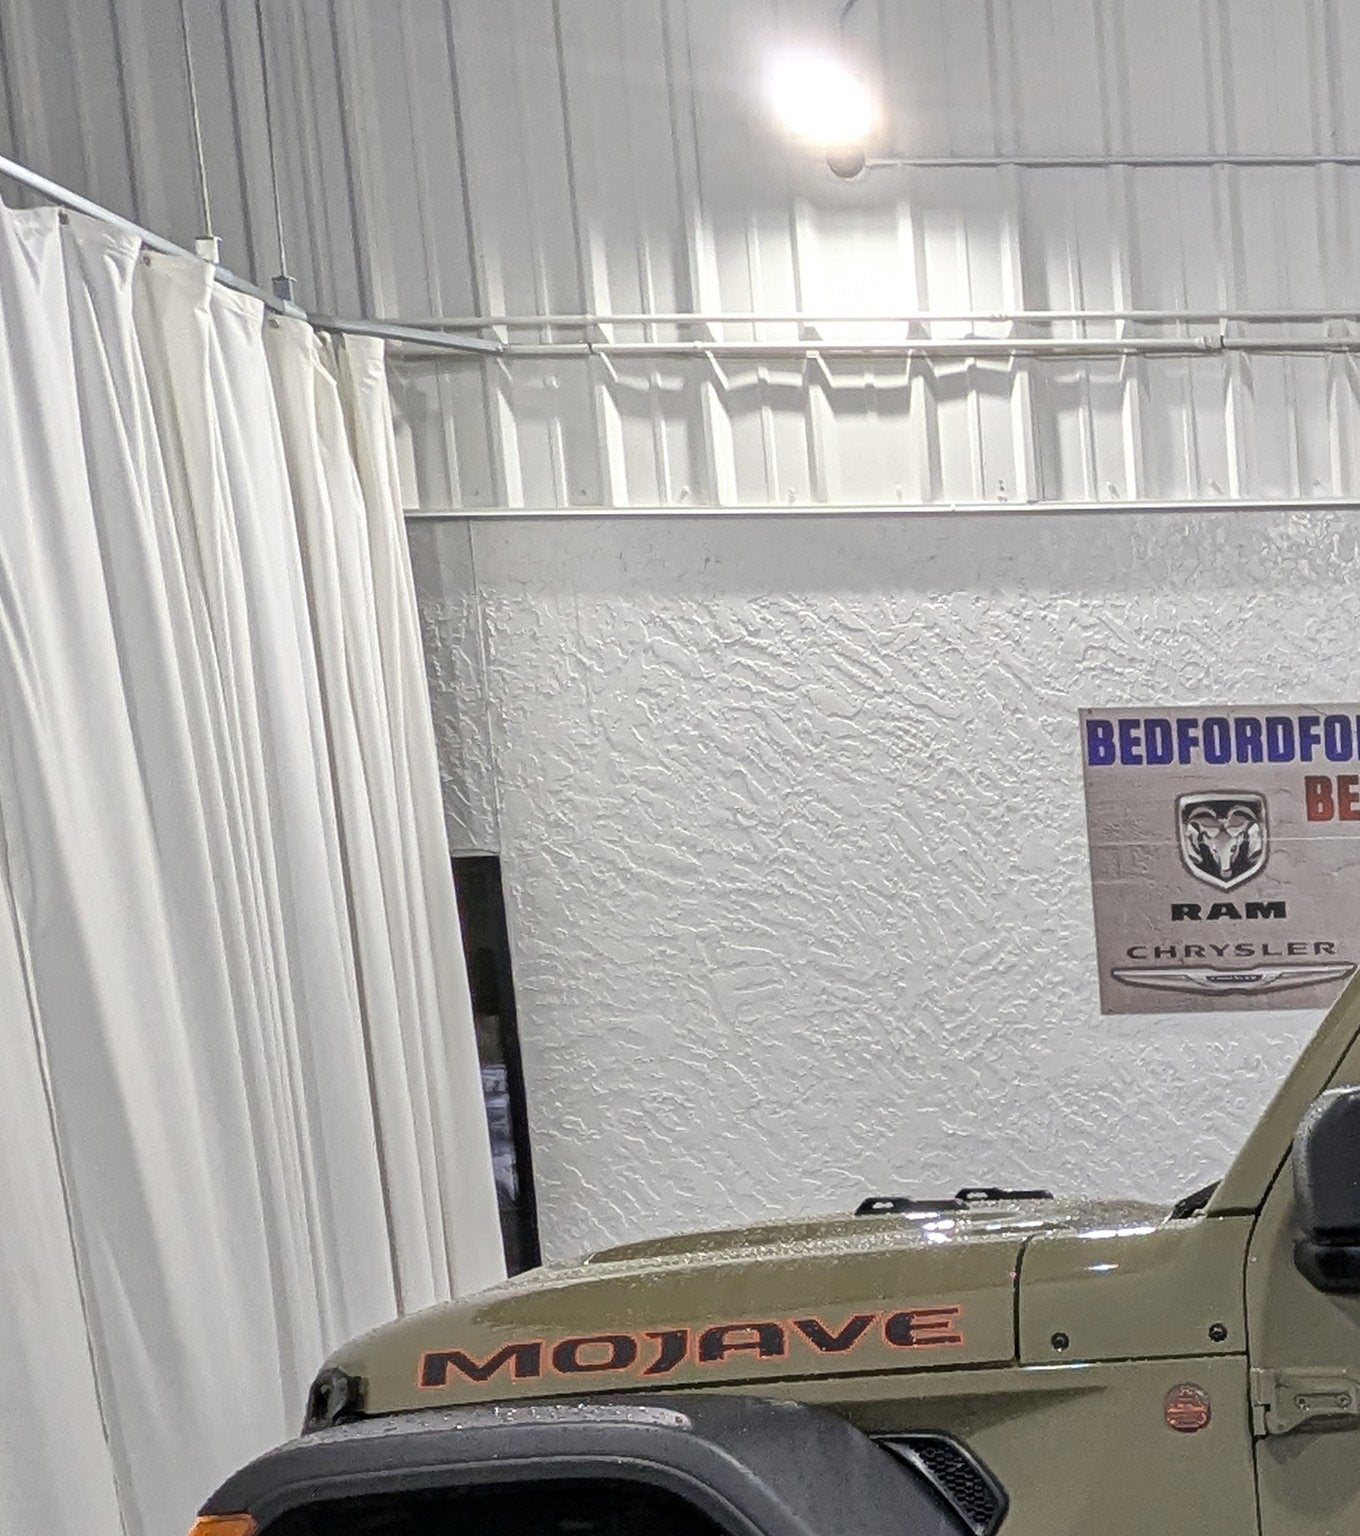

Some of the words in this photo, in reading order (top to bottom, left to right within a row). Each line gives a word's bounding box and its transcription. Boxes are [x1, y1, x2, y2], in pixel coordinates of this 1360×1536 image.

[1170, 900, 1287, 922] RAM
[1126, 941, 1338, 960] CHRYSLER
[418, 1305, 964, 1389] MOJAVE
